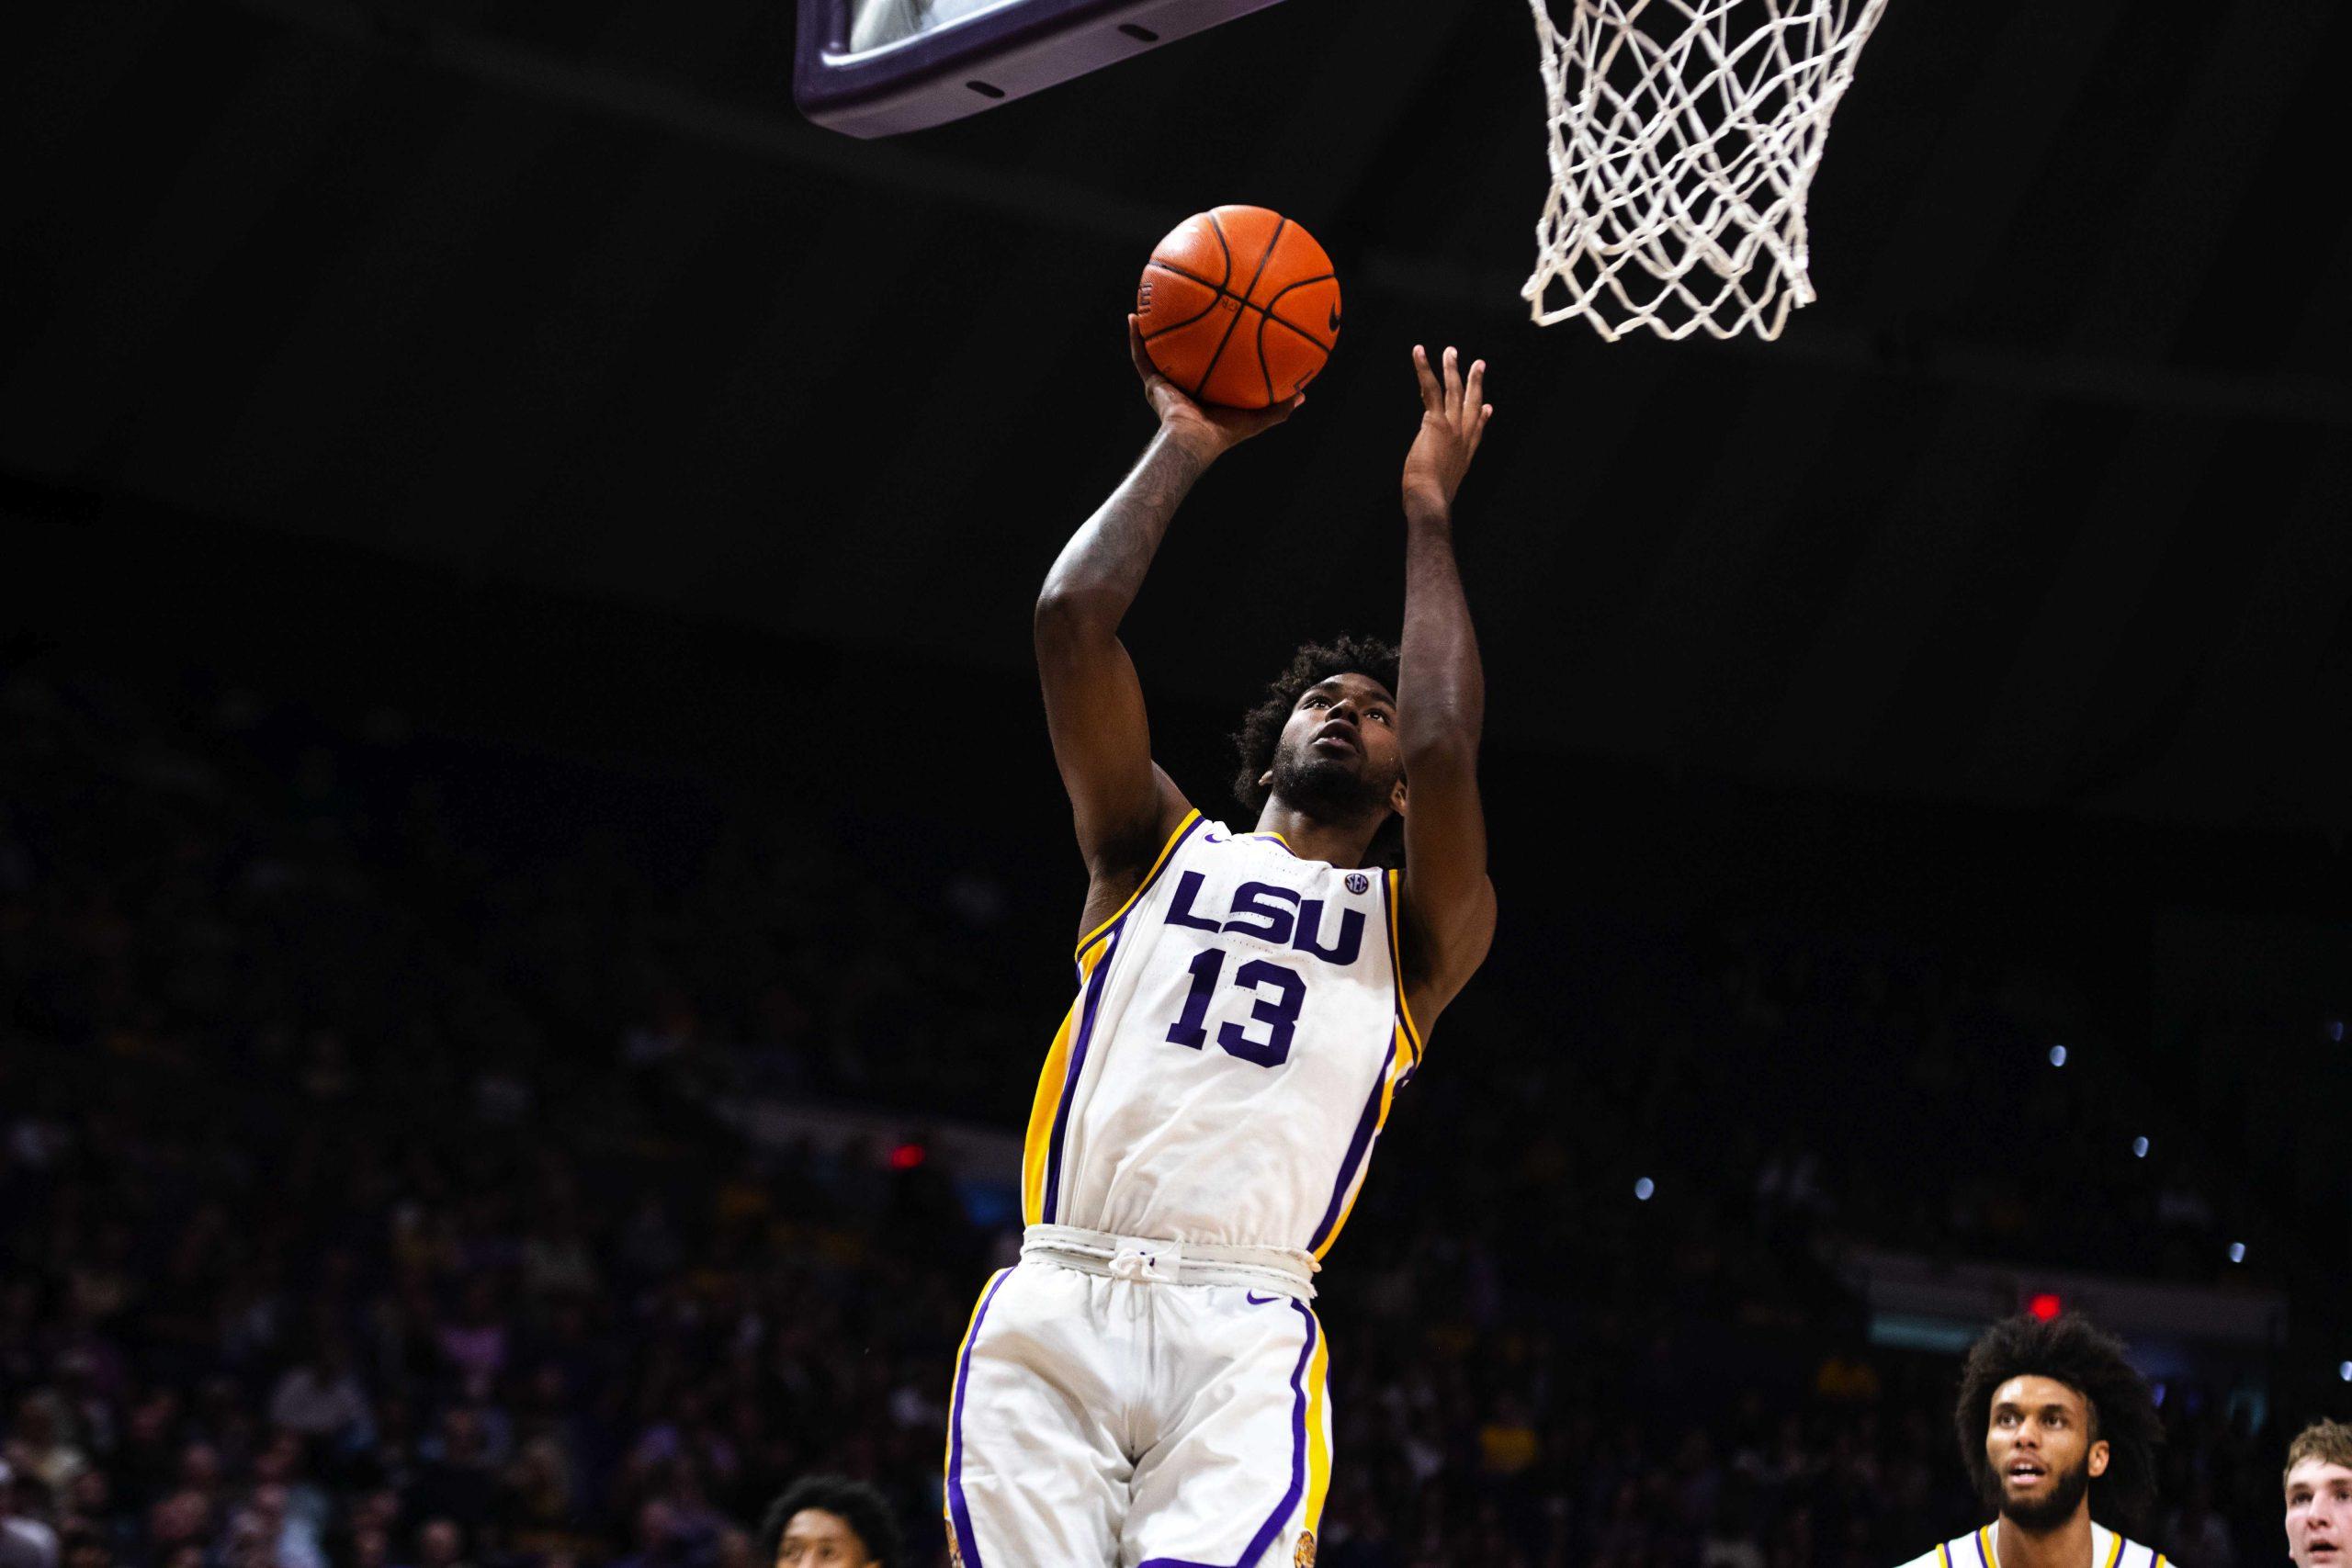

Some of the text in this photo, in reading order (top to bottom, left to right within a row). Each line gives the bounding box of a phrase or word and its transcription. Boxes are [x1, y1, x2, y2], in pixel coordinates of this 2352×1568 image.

[1164, 870, 1366, 965] LSU
[1346, 874, 1368, 894] SEC
[1166, 947, 1307, 1069] 13
